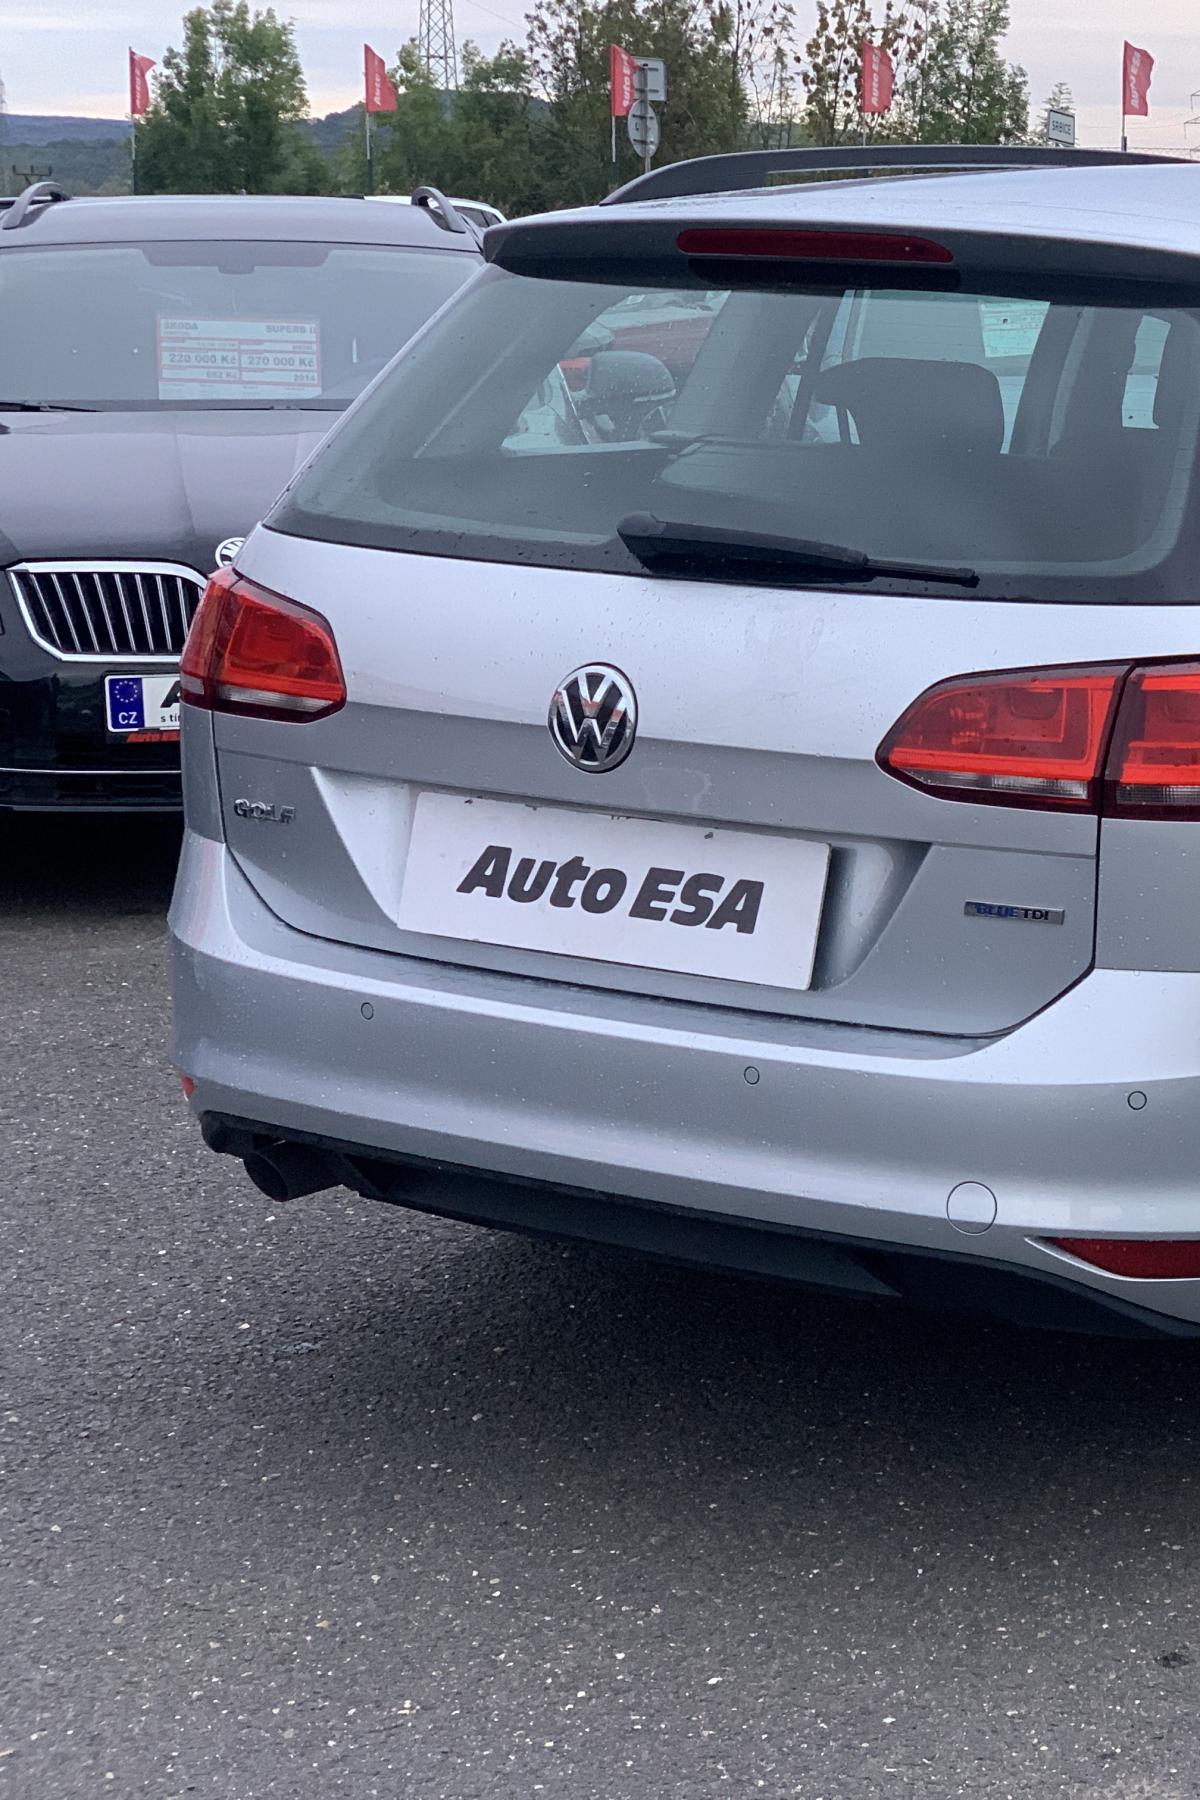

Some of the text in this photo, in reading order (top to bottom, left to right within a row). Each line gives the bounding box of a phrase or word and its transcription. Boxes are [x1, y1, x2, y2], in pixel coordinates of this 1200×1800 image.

[168, 353, 191, 363] 220
[247, 356, 270, 366] 270
[272, 357, 295, 367] 000
[118, 711, 138, 724] CZ
[234, 798, 296, 824] GOLF
[456, 845, 765, 935] Auto ESA
